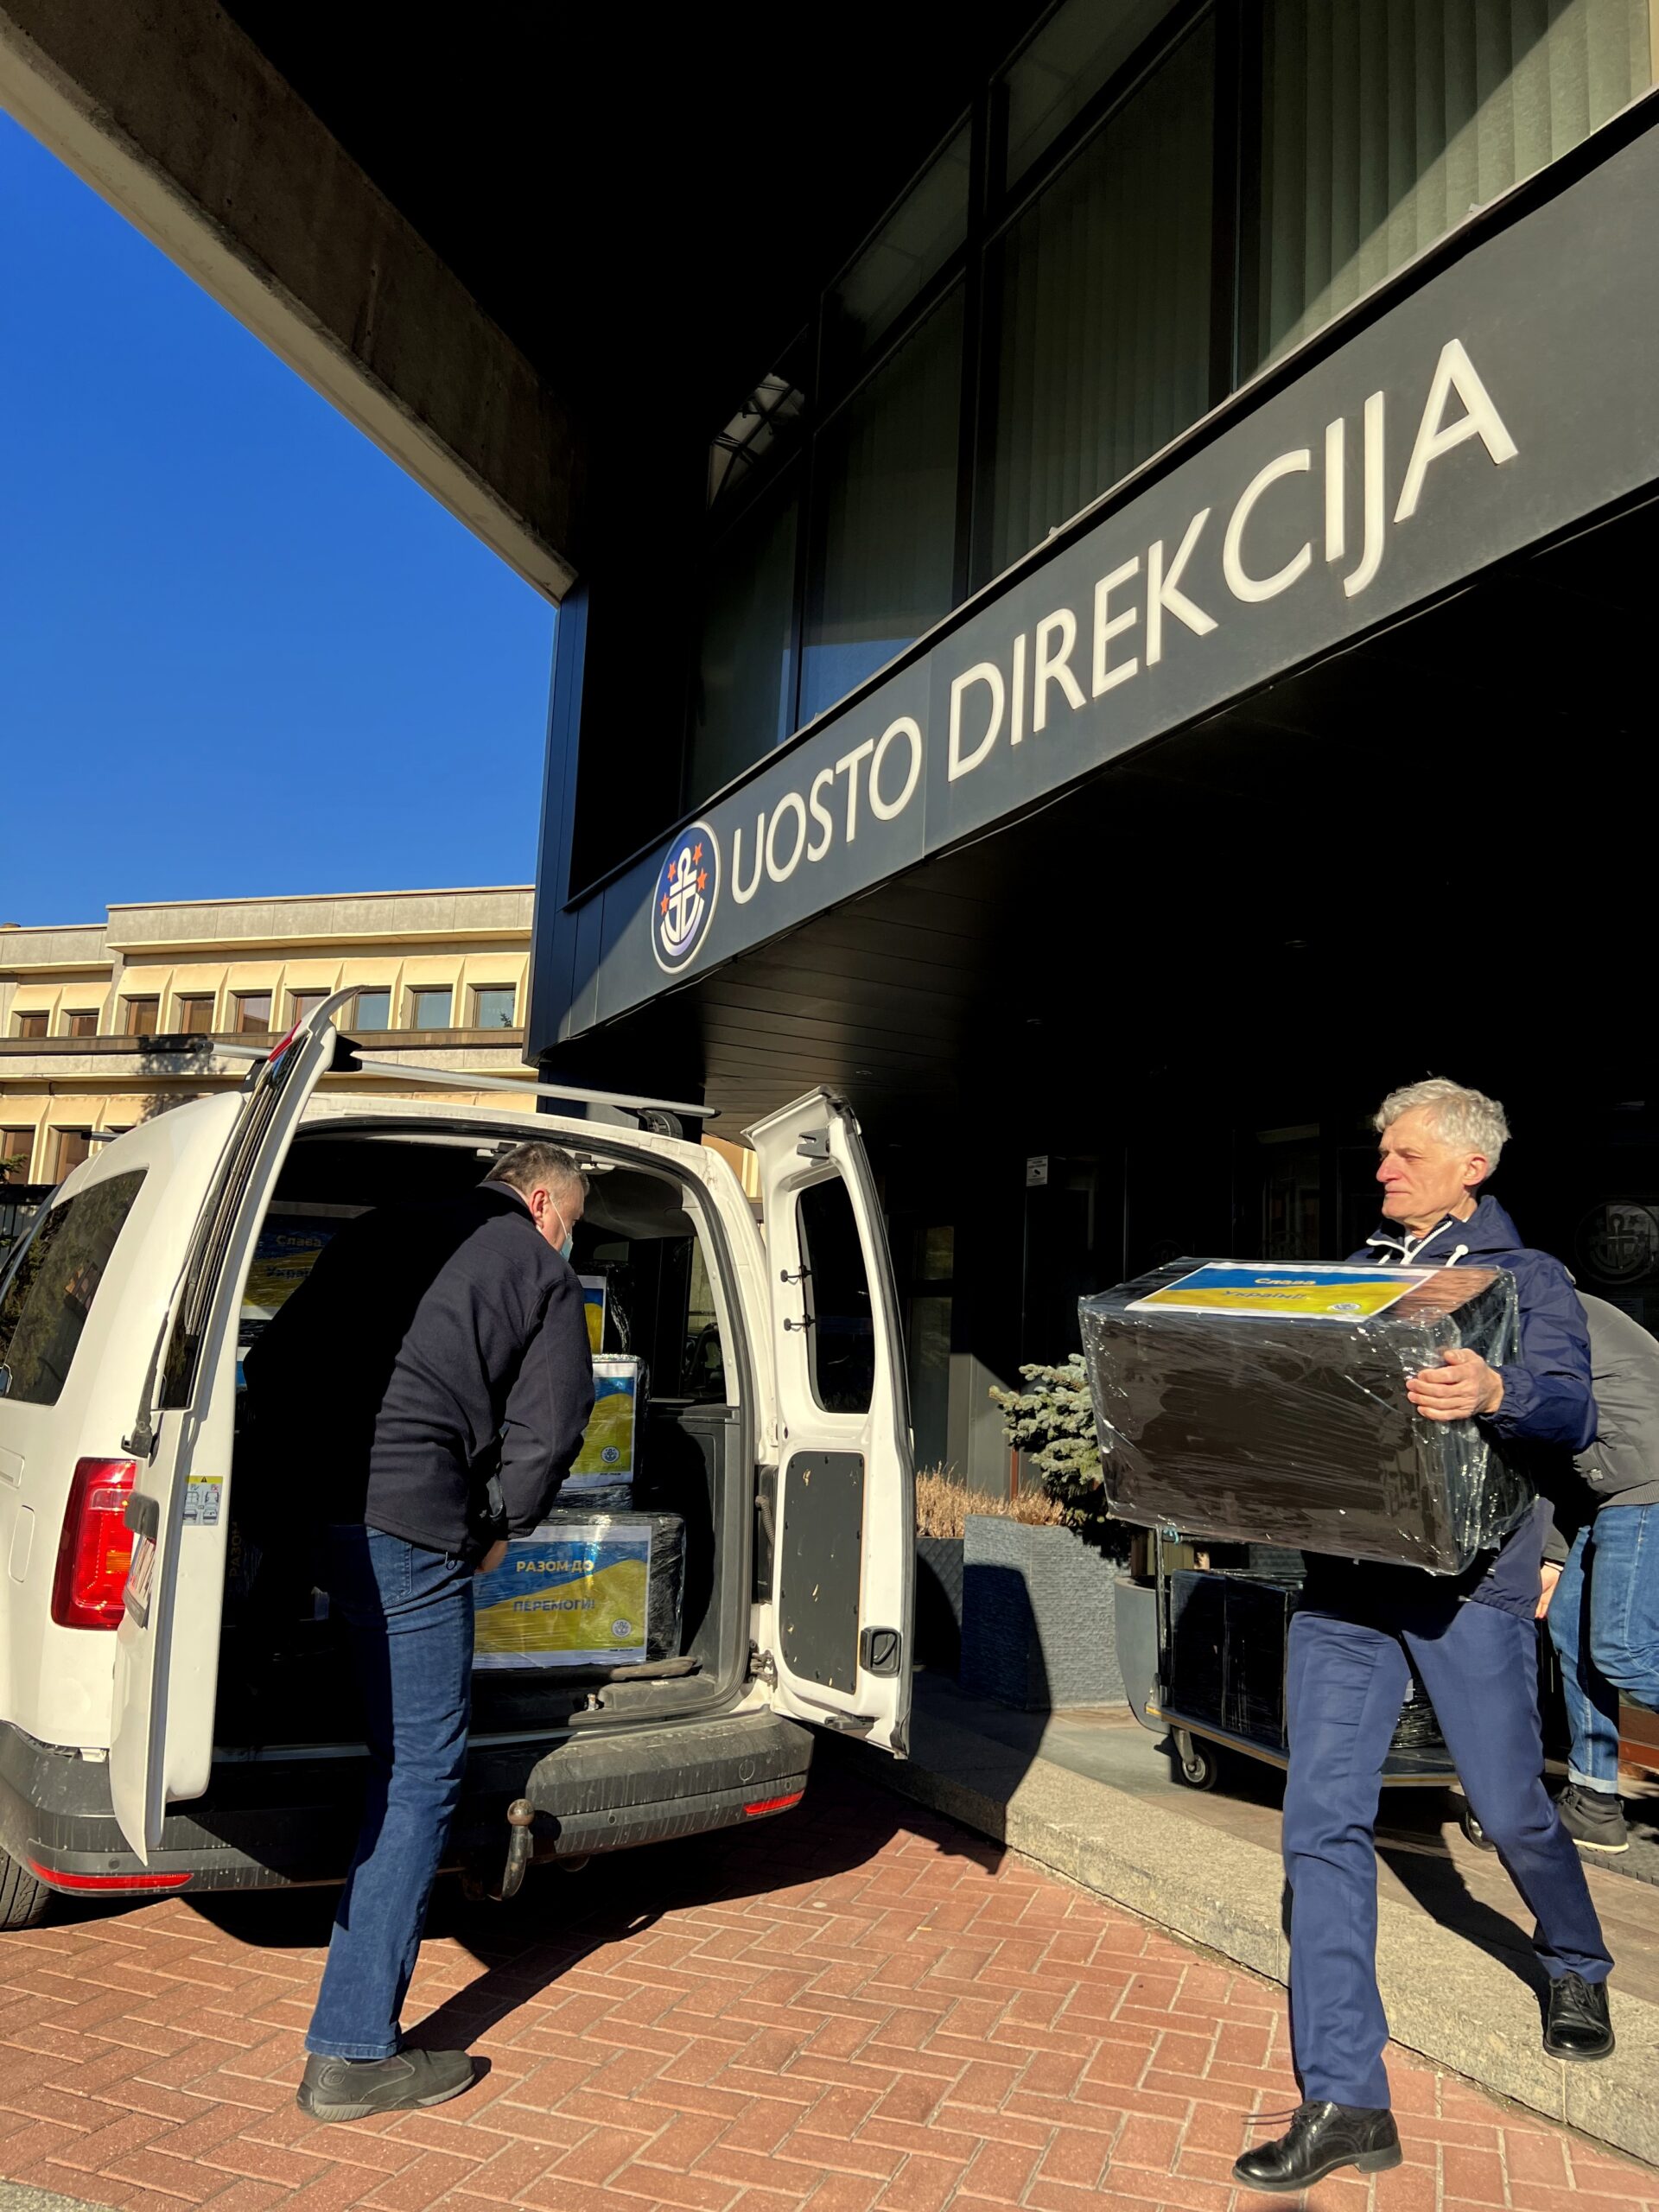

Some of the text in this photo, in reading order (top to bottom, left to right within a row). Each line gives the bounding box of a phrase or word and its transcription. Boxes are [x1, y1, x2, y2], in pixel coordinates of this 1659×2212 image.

[732, 338, 1519, 905] UOSTO DIREKCIJA
[276, 1235, 322, 1247] Слава
[516, 1560, 594, 1573] РАЗОМ ДО
[513, 1599, 595, 1611] ПЕРЕМОГИ!
